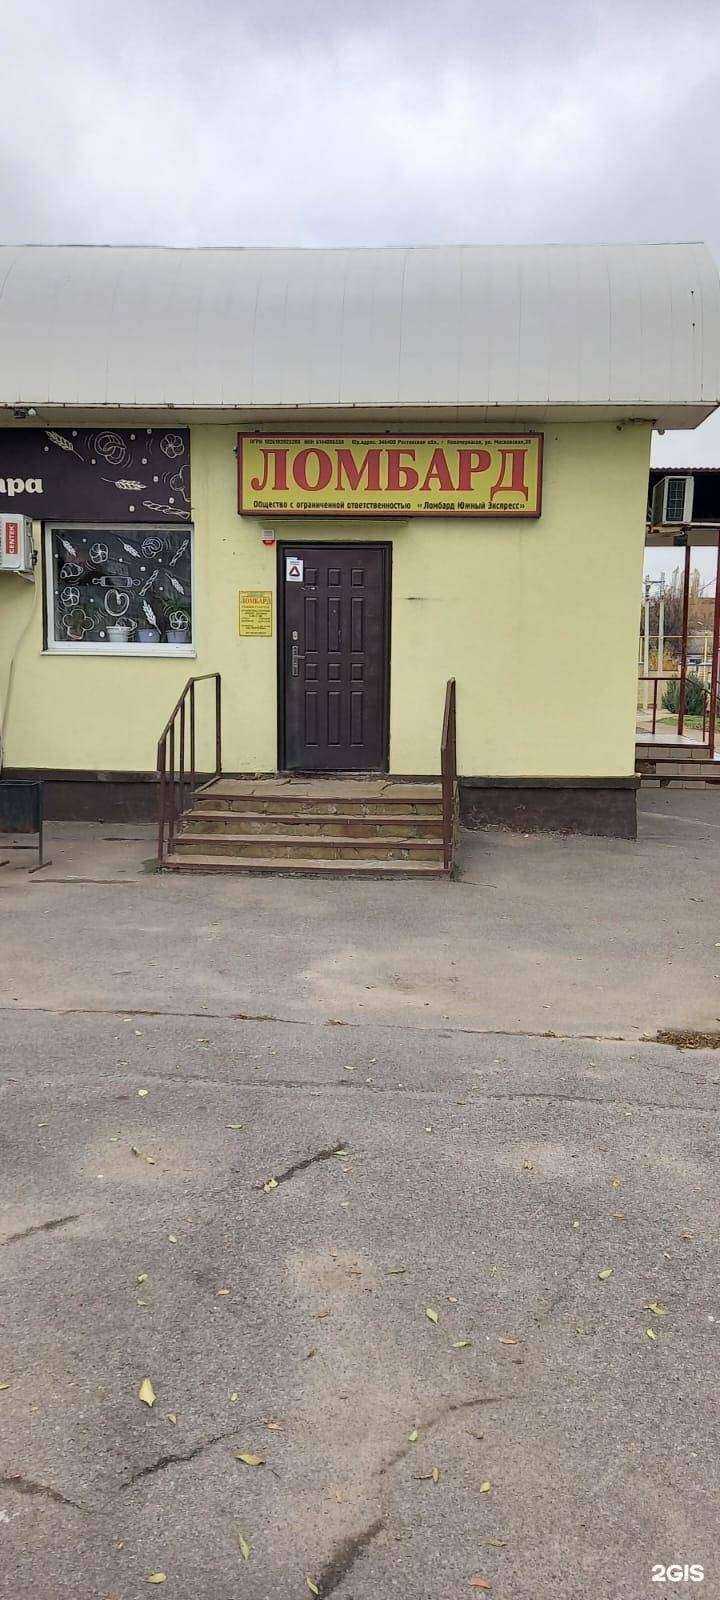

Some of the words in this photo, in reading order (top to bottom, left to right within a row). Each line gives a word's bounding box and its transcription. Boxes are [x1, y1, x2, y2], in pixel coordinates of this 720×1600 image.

[250, 448, 529, 501] ЛОМБАРД
[253, 500, 288, 509] Общество
[296, 501, 345, 510] ограниченной
[346, 502, 411, 510] ответственностью
[457, 502, 485, 510] Южный
